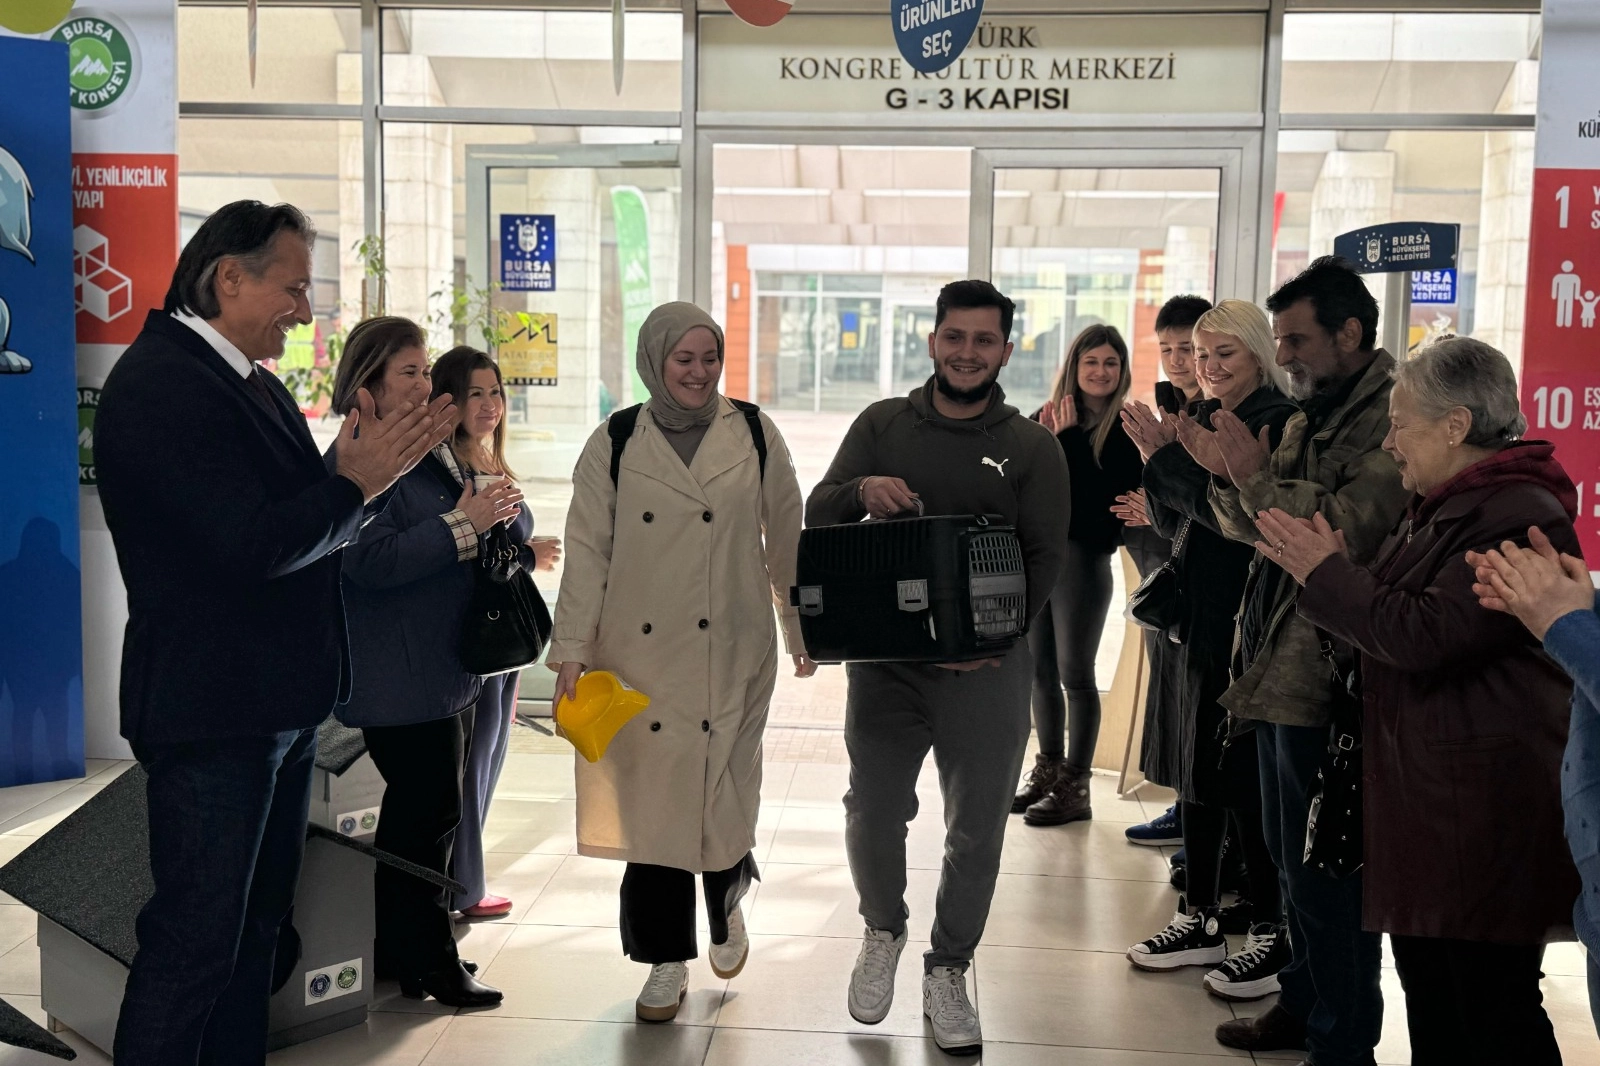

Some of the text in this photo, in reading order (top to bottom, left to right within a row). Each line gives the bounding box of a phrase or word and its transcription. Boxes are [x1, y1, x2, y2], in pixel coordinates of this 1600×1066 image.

[61, 20, 113, 42] BURSA
[969, 22, 1037, 49] ÜRK
[922, 29, 952, 59] SEÇ
[780, 57, 902, 80] KONGRE
[1049, 52, 1177, 80] MERKEZİ
[78, 60, 127, 104] KONSEYİ
[886, 88, 908, 109] G
[938, 88, 955, 109] 3
[964, 88, 1070, 109] KAPISI
[86, 165, 167, 189] YENİLİKÇİLİK
[1555, 185, 1570, 229] 1
[1392, 233, 1431, 246] BURSA
[505, 260, 552, 272] BURSA
[1392, 251, 1431, 262] BELEDİYESİ
[1412, 271, 1452, 283] URSA
[1412, 281, 1452, 291] YÜKŞEHİR
[1412, 290, 1452, 301] LEDİYESİ
[1533, 386, 1573, 430] 10
